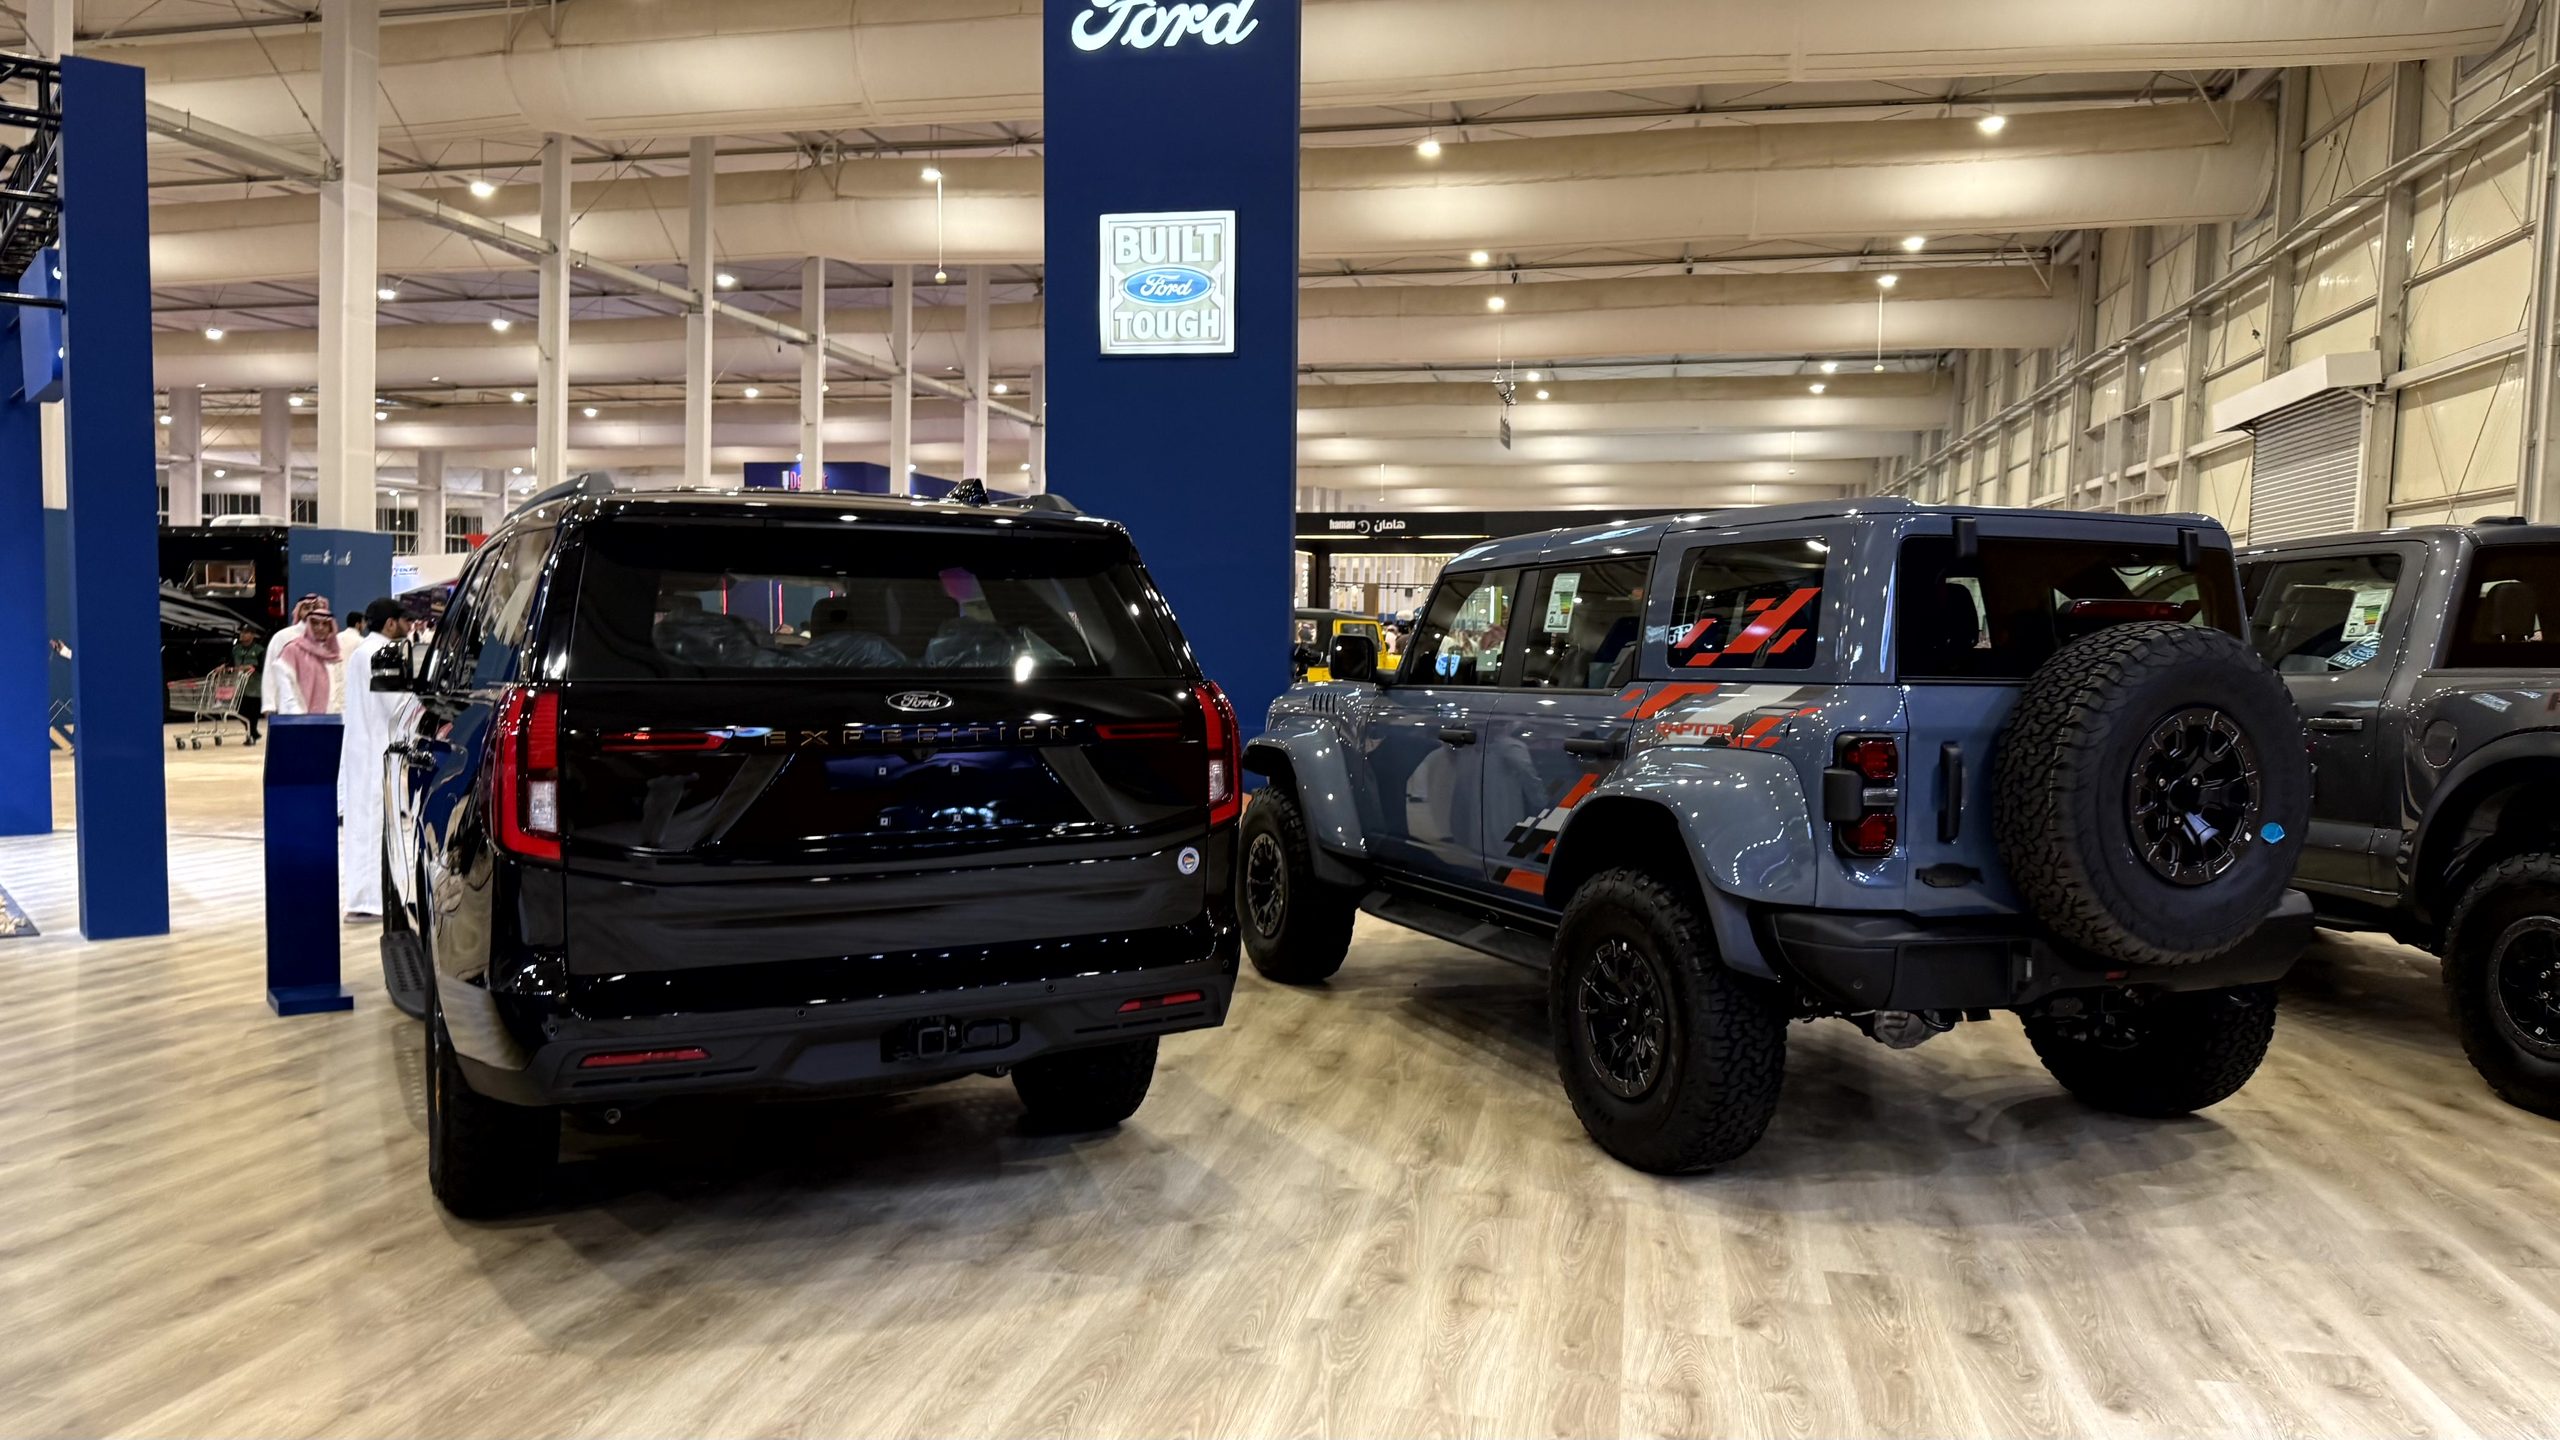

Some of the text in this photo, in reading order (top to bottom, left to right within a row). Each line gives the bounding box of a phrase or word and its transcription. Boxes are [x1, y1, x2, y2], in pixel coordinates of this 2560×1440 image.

[1071, 0, 1259, 51] Ford
[1115, 224, 1221, 264] BUILT
[1140, 273, 1193, 297] Ford
[1114, 310, 1220, 340] TOUGH
[1329, 519, 1356, 530] haman
[1374, 519, 1406, 533] هامان
[901, 694, 940, 708] Ford
[764, 725, 1070, 747] EXPEDITION
[1656, 722, 1735, 745] RAPTOR
